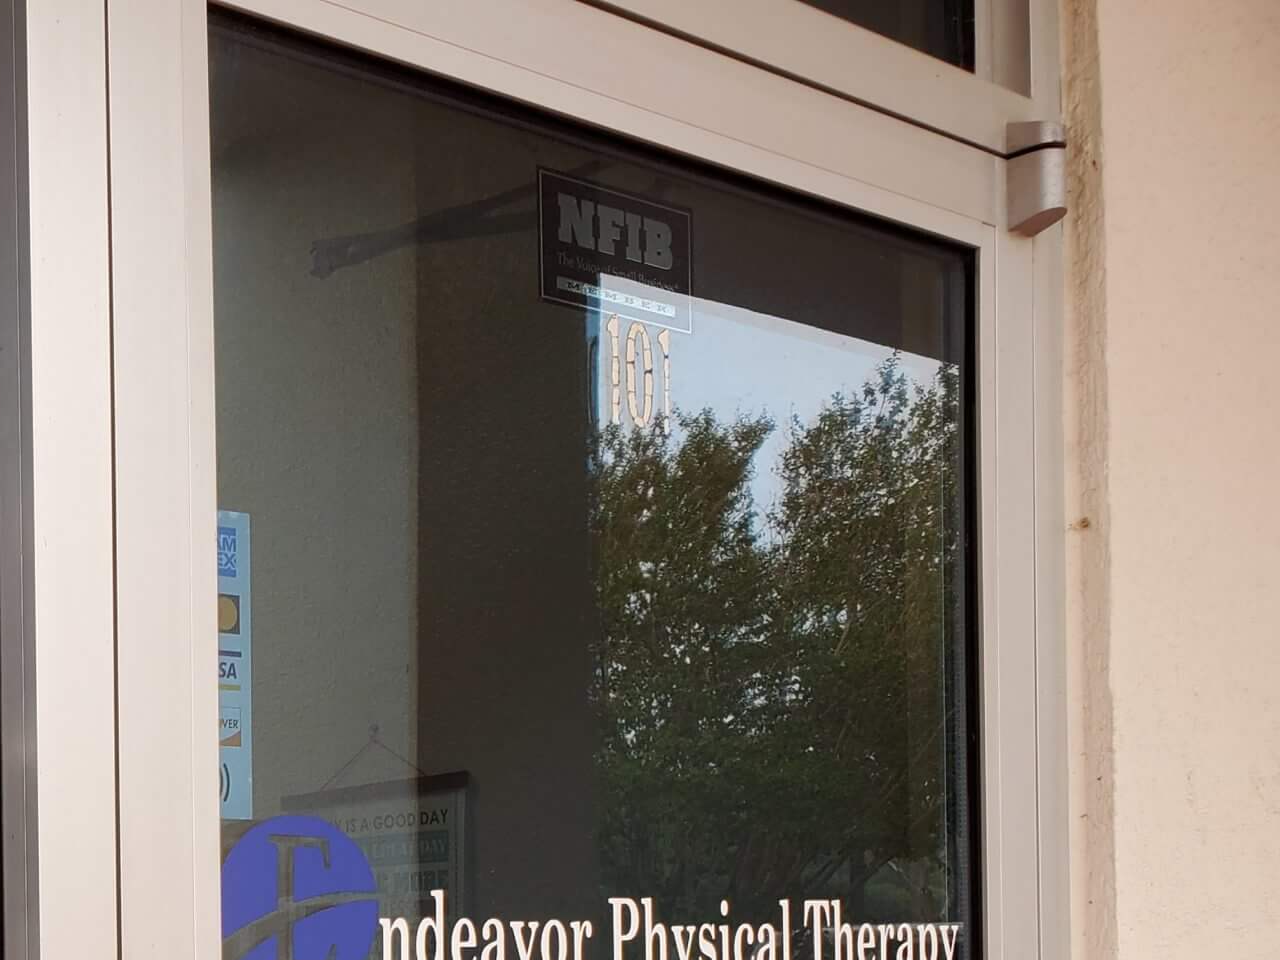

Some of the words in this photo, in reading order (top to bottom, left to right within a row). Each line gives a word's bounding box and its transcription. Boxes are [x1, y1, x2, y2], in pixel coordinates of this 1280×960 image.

[557, 192, 672, 270] NFIB
[373, 812, 417, 829] GOOD
[420, 808, 448, 826] DAY
